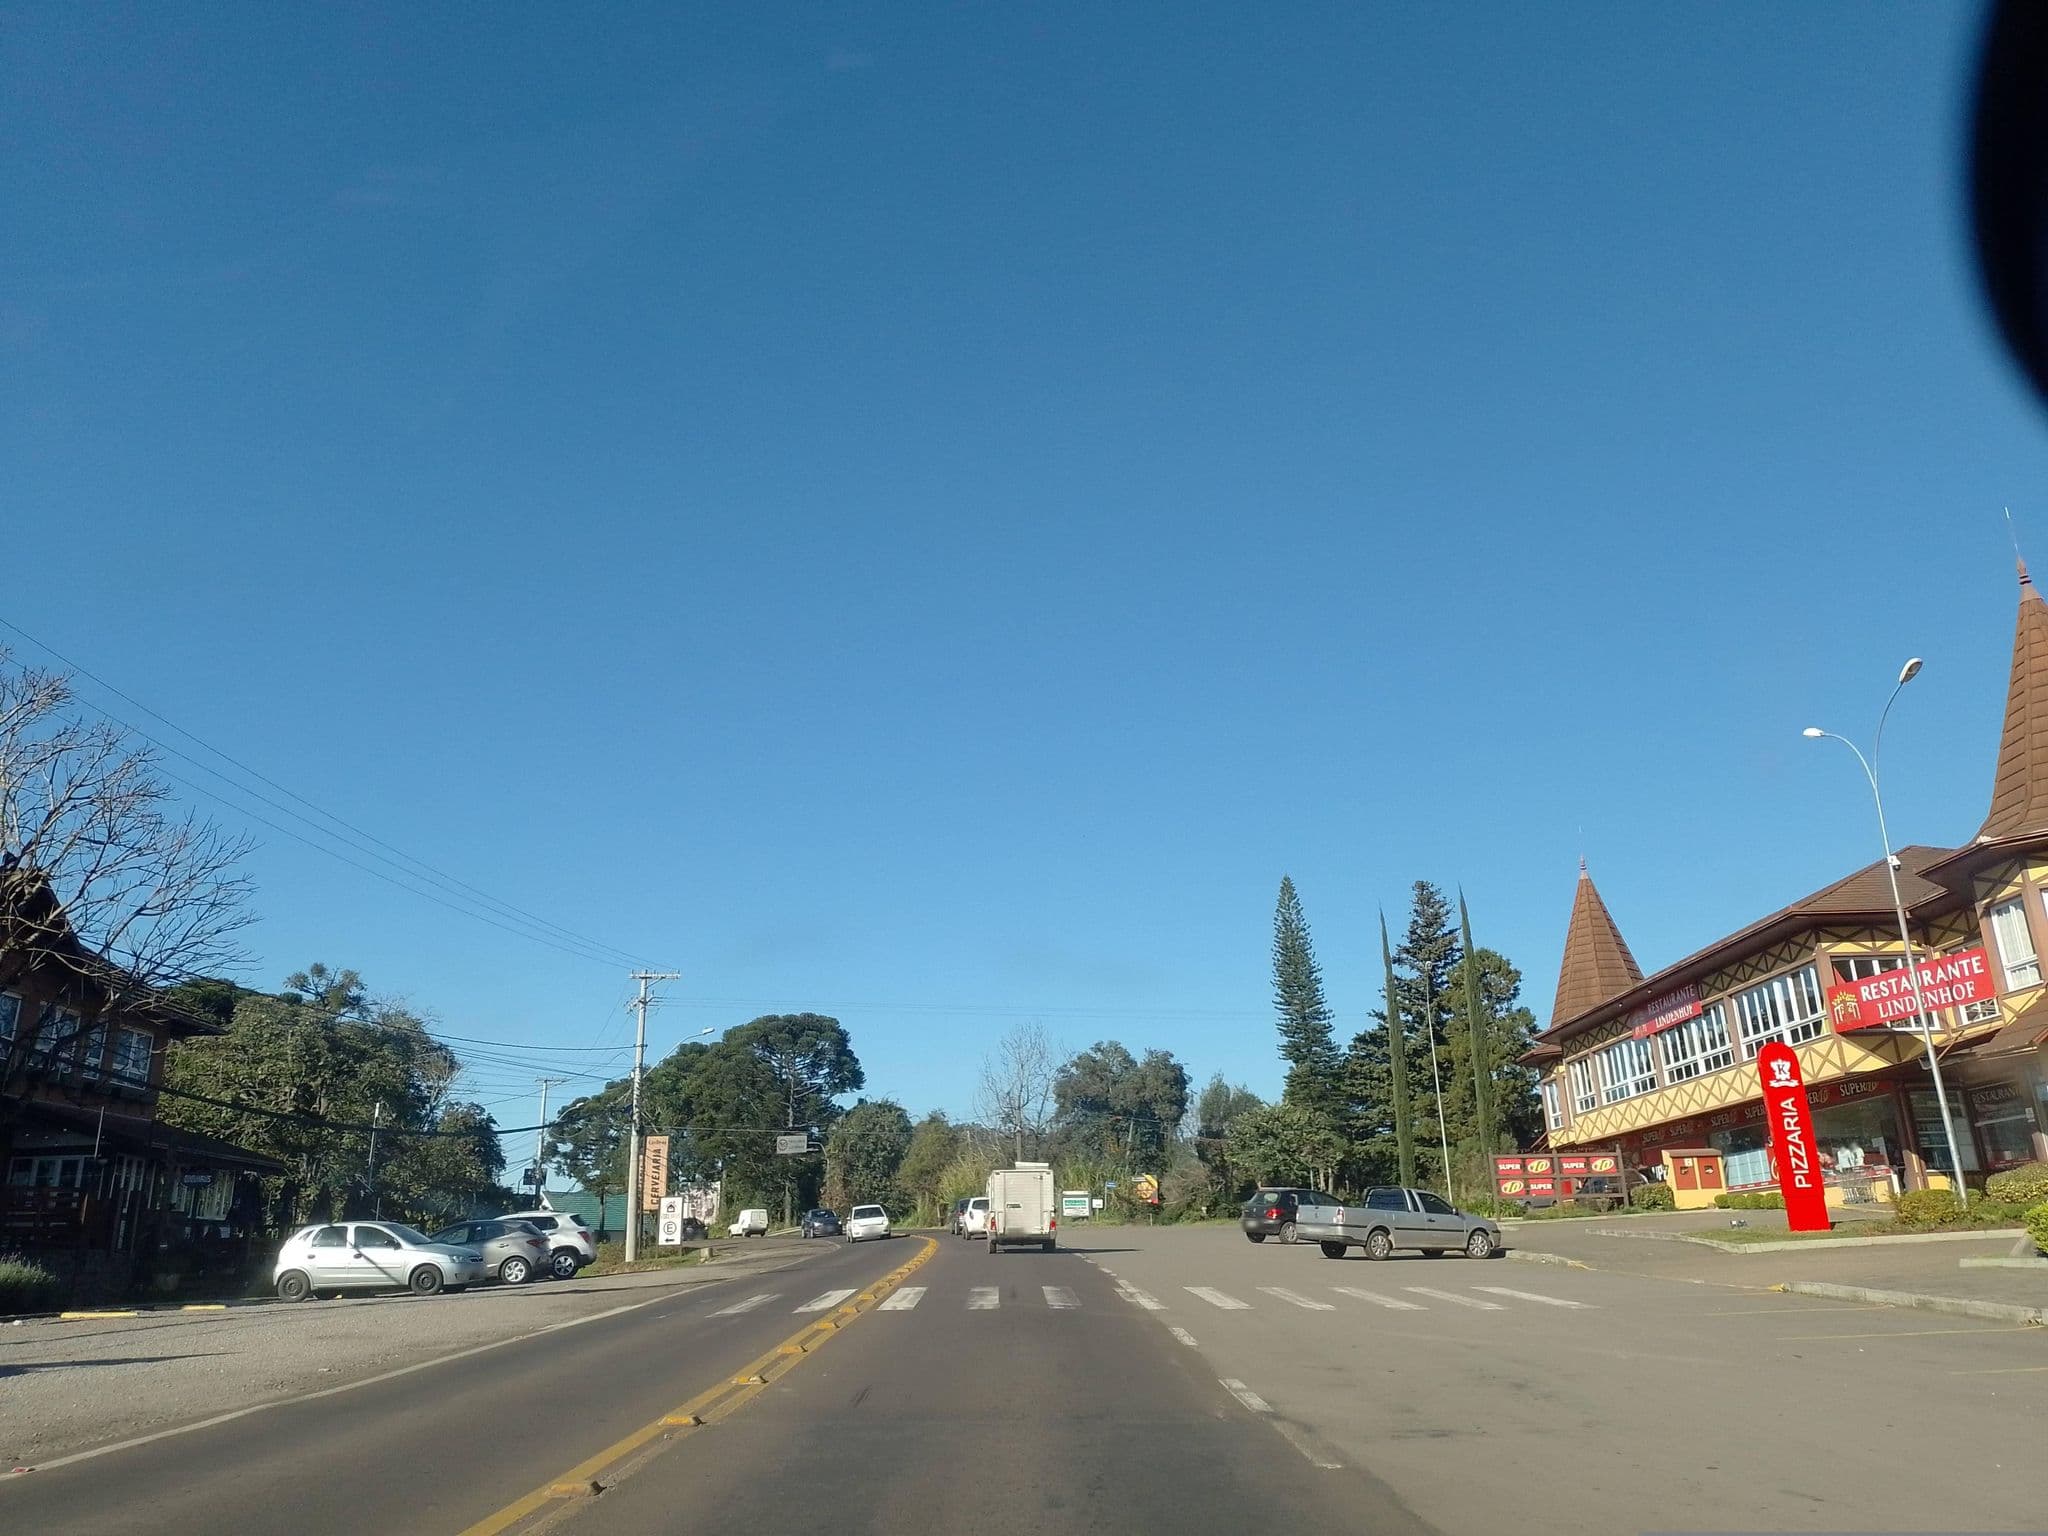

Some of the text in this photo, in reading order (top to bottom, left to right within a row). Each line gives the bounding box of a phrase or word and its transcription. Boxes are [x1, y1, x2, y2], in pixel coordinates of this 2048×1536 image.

[1860, 955, 1984, 1002] RESTAURANTE
[1877, 981, 1976, 1018] LINDENHOF
[1780, 1097, 1813, 1188] PIZZARIA
[651, 1148, 662, 1205] CERVEJARIA
